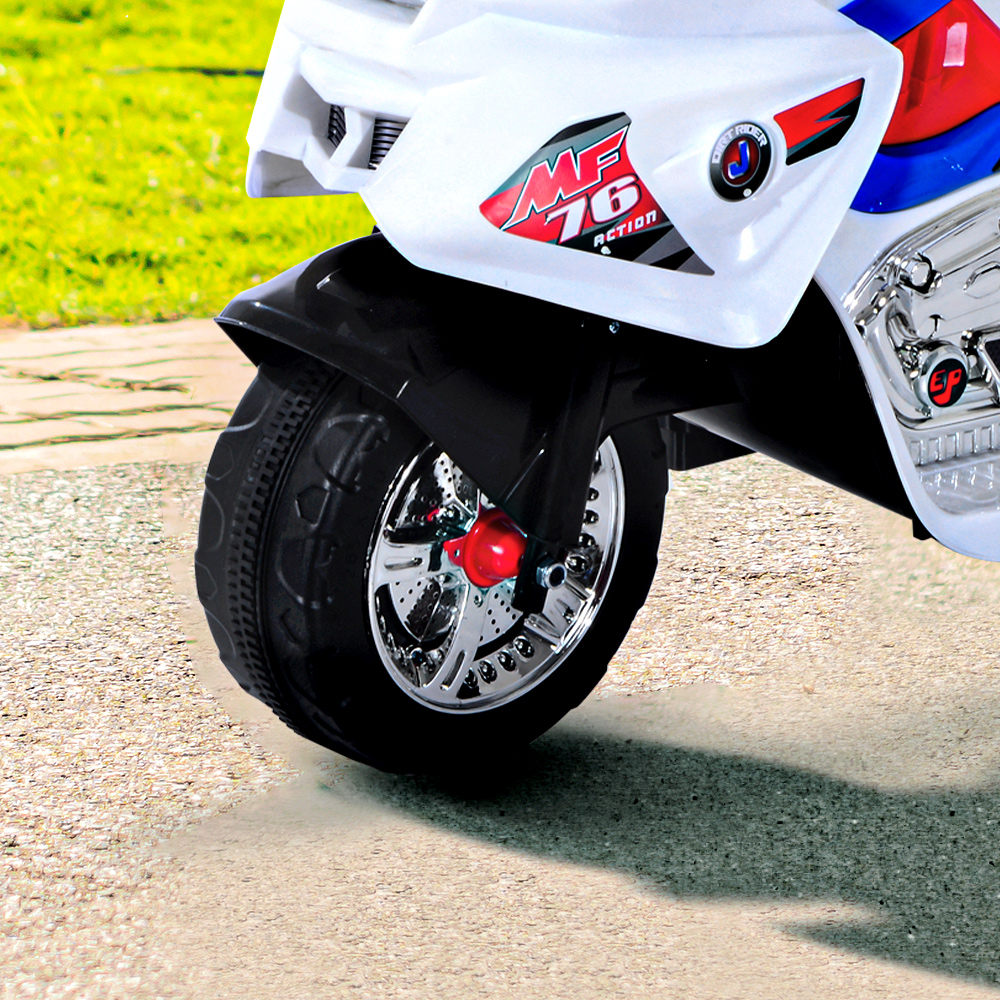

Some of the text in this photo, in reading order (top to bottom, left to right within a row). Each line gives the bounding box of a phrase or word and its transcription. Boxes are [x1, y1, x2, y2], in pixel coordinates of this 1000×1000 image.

[711, 123, 768, 164] DIRT RIDER
[728, 140, 750, 179] J
[502, 125, 629, 231] MF
[544, 173, 642, 246] 76
